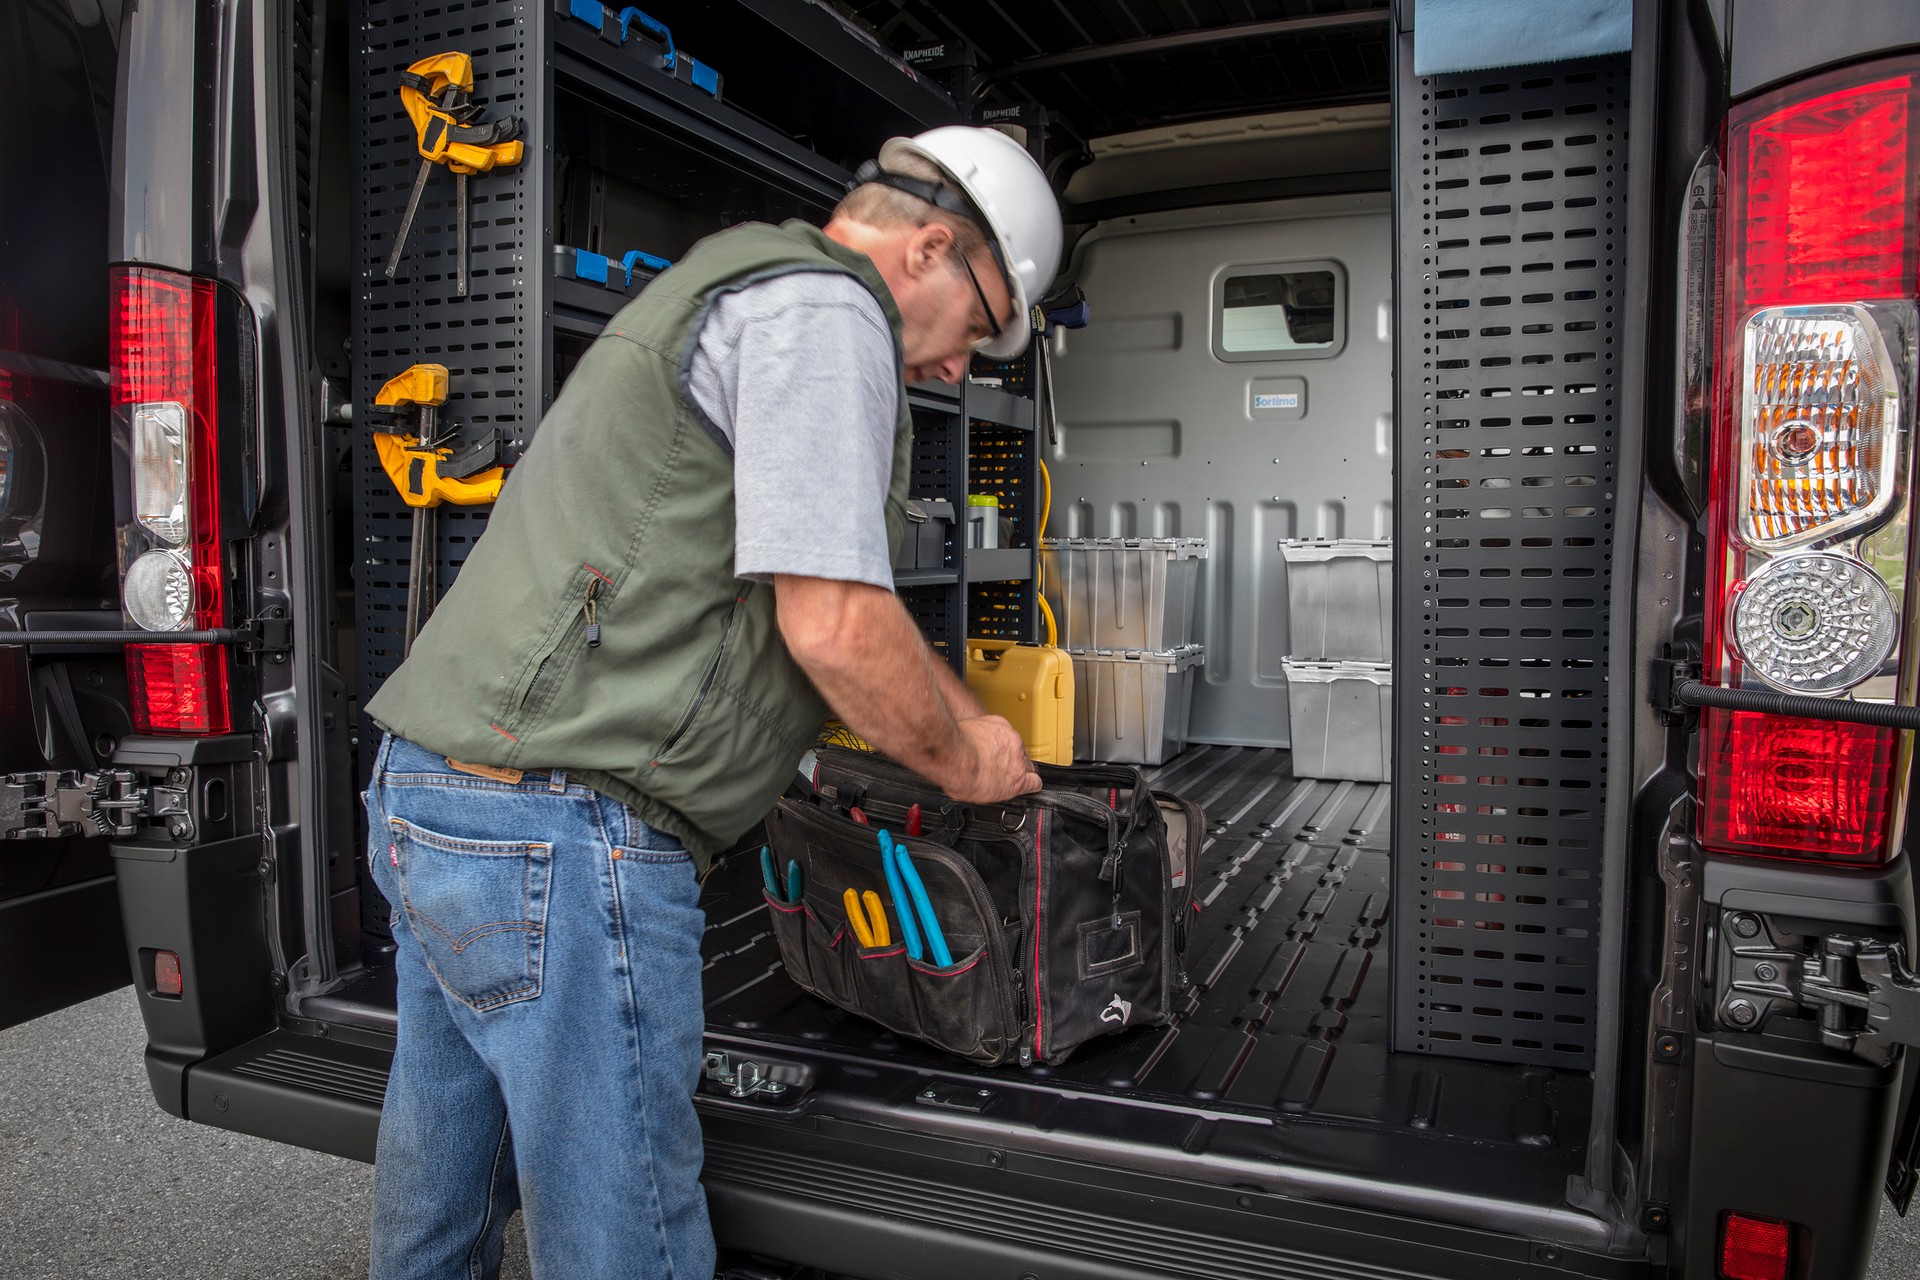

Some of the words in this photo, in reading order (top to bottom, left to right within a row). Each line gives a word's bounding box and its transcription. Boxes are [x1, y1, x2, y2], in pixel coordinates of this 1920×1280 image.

[903, 44, 945, 61] KNAPHEIDE
[983, 105, 1020, 121] KNAPHEIDE
[1255, 395, 1296, 407] Sortimo
